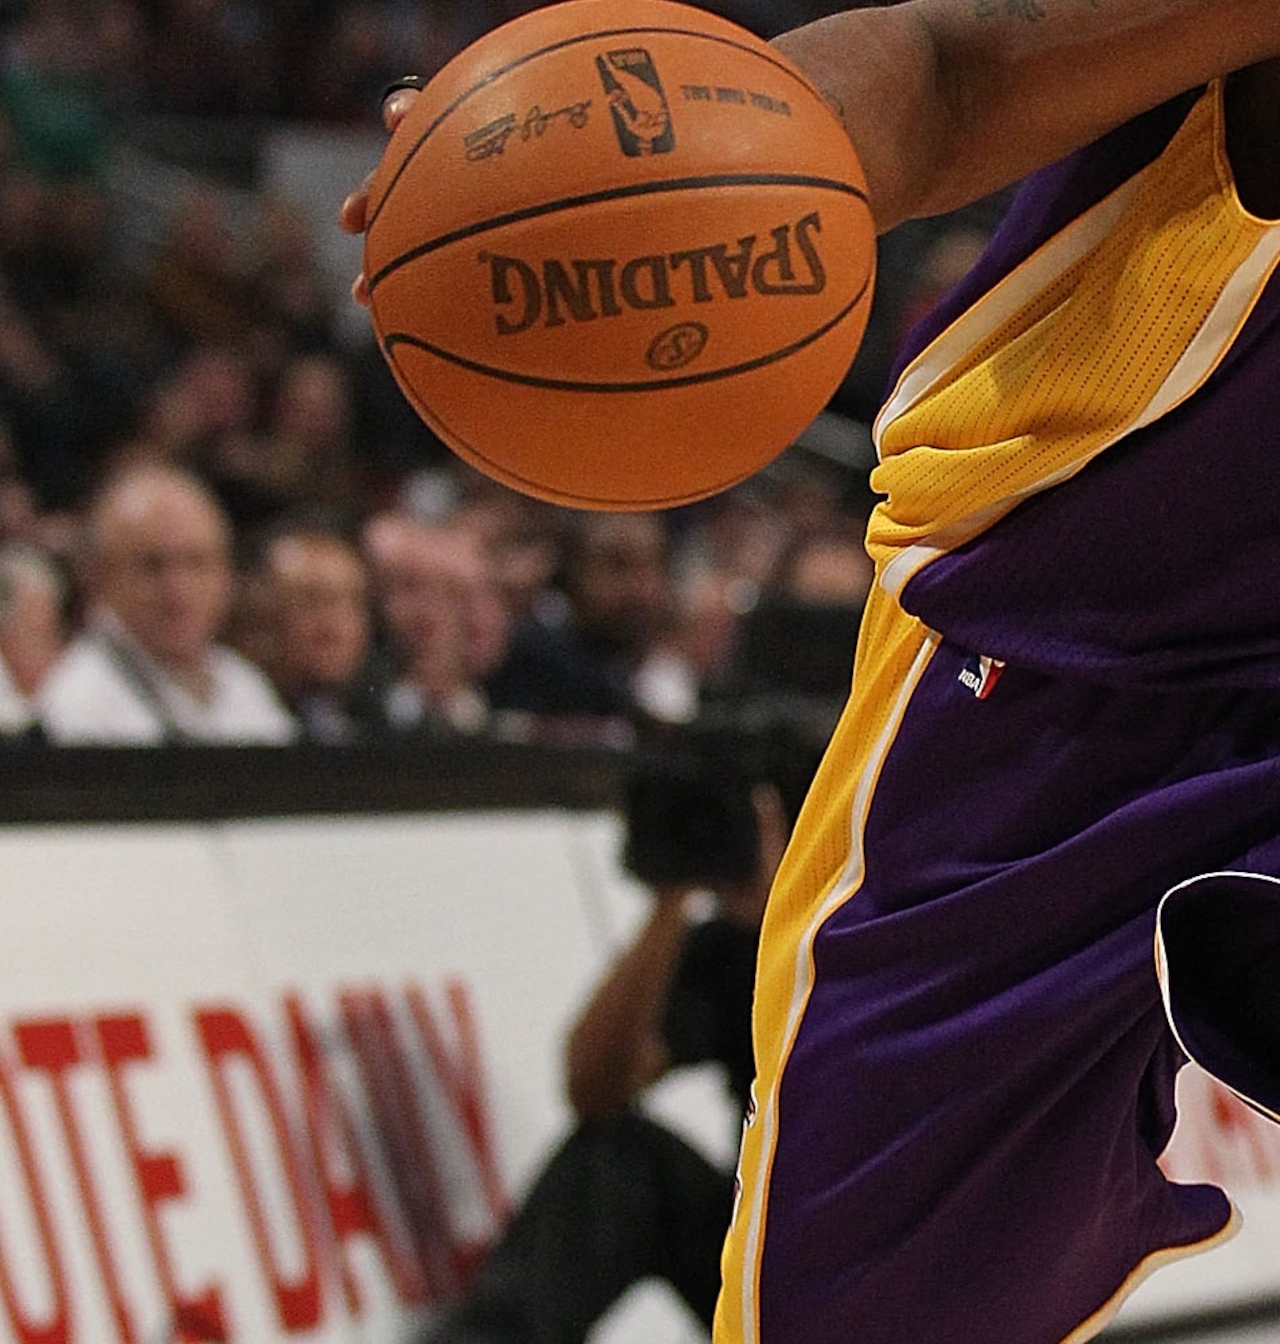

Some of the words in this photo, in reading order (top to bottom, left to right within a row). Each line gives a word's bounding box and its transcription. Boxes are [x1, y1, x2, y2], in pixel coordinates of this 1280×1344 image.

[484, 211, 828, 336] SPALDING
[957, 667, 982, 692] NBA
[190, 973, 514, 1337] DAILY
